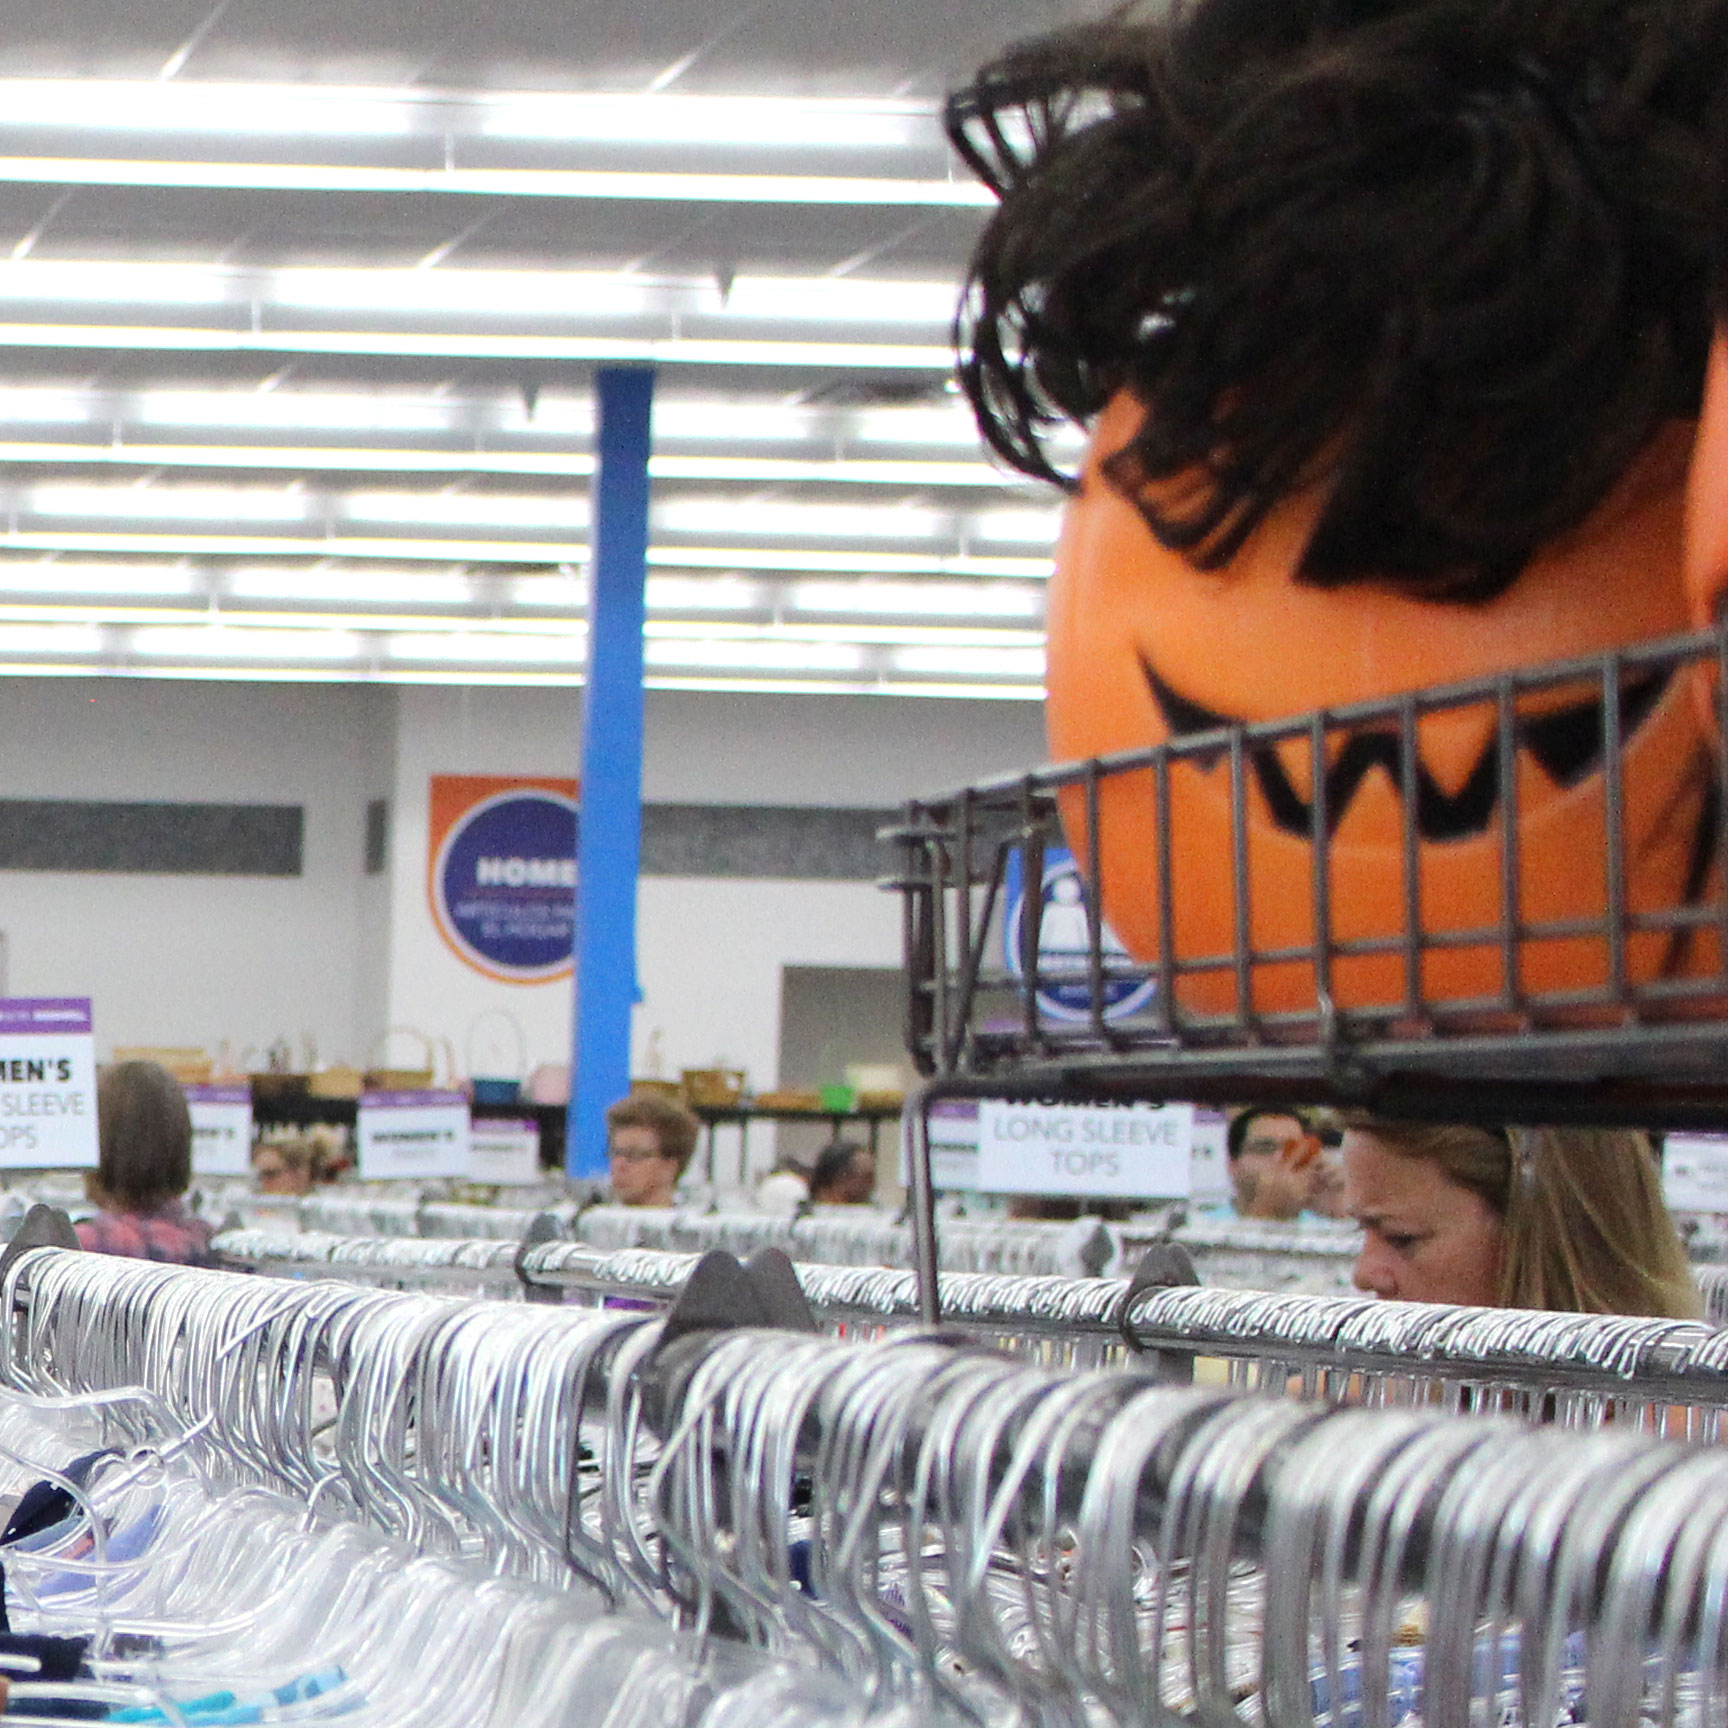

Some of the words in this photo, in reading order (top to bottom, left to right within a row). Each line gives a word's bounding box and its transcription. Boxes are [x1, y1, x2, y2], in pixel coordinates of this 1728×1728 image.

[476, 856, 578, 887] HOME
[3, 1092, 87, 1117] SLEEVE
[994, 1116, 1073, 1142] LONG
[1082, 1118, 1179, 1145] SLEEVE
[1051, 1151, 1120, 1176] TOPS
